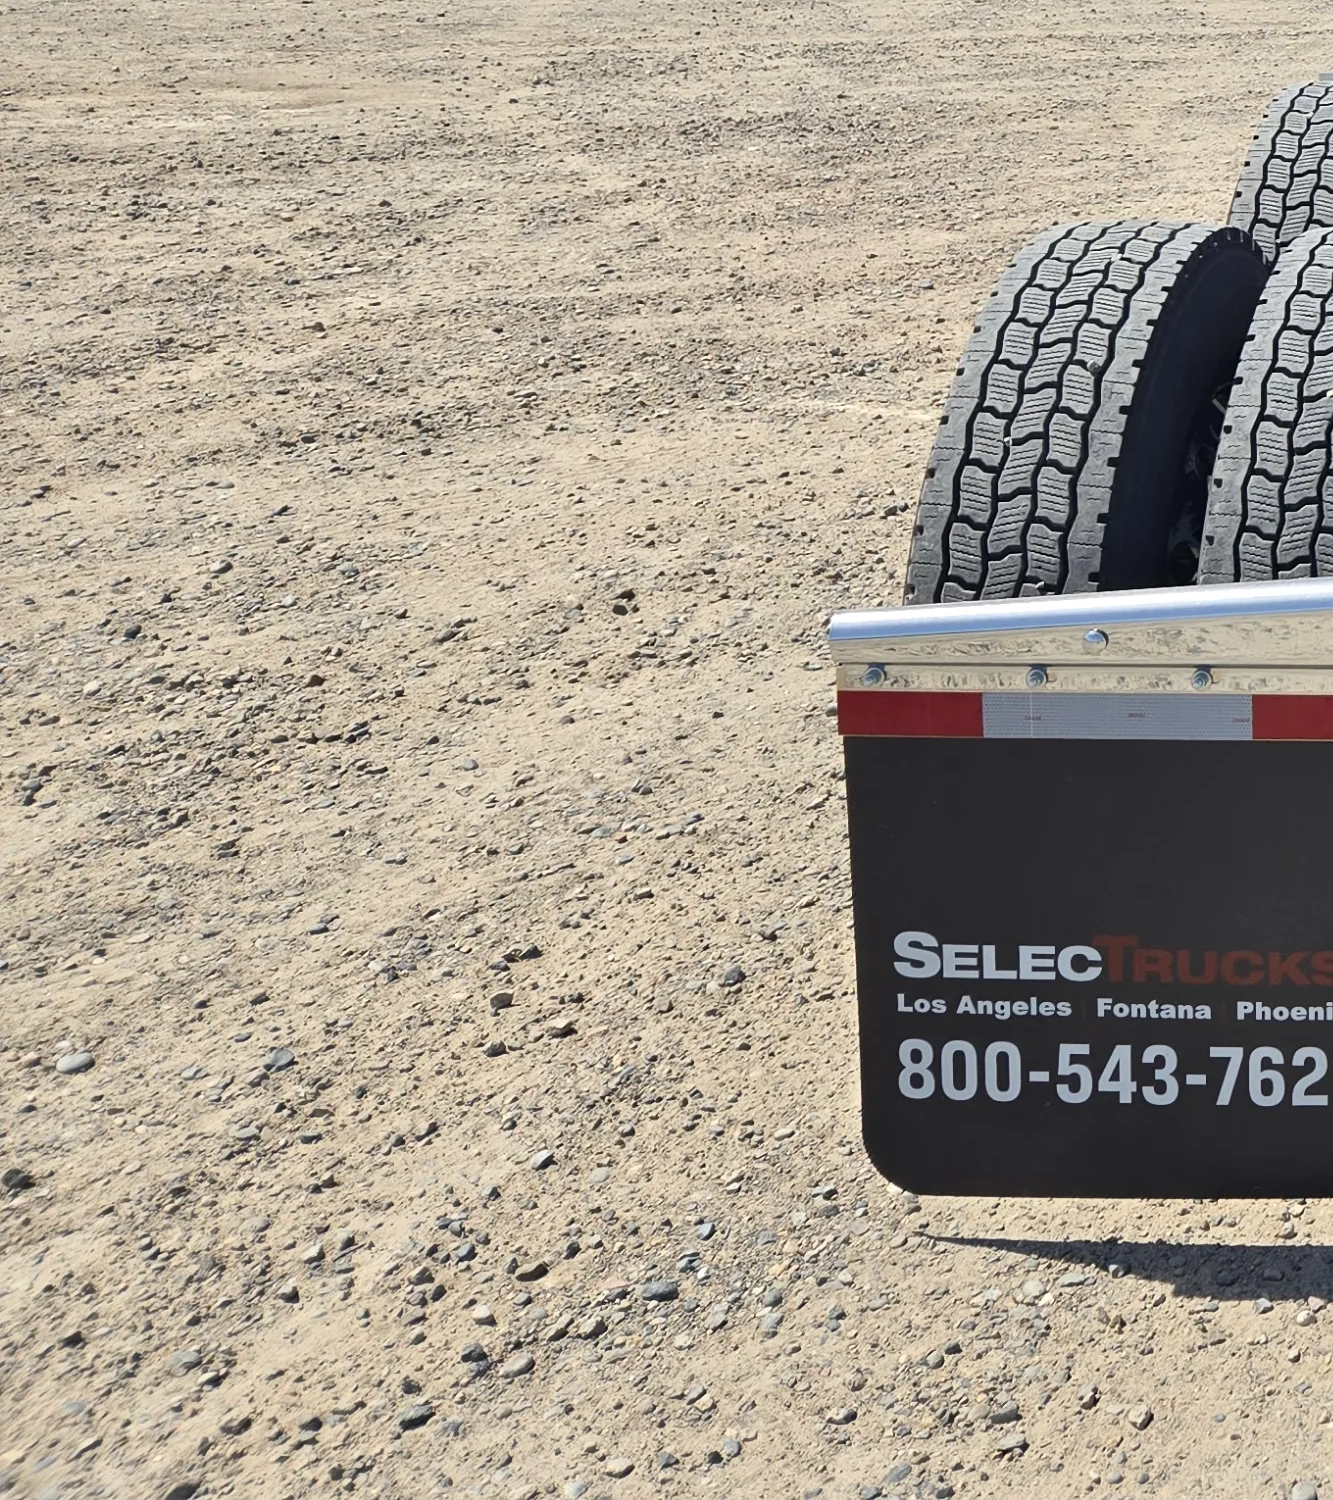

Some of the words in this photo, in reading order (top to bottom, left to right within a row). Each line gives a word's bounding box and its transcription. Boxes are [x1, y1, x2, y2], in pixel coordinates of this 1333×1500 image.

[896, 993, 947, 1014] Los
[956, 995, 1073, 1020] Angeles
[1097, 997, 1212, 1020] Fontana
